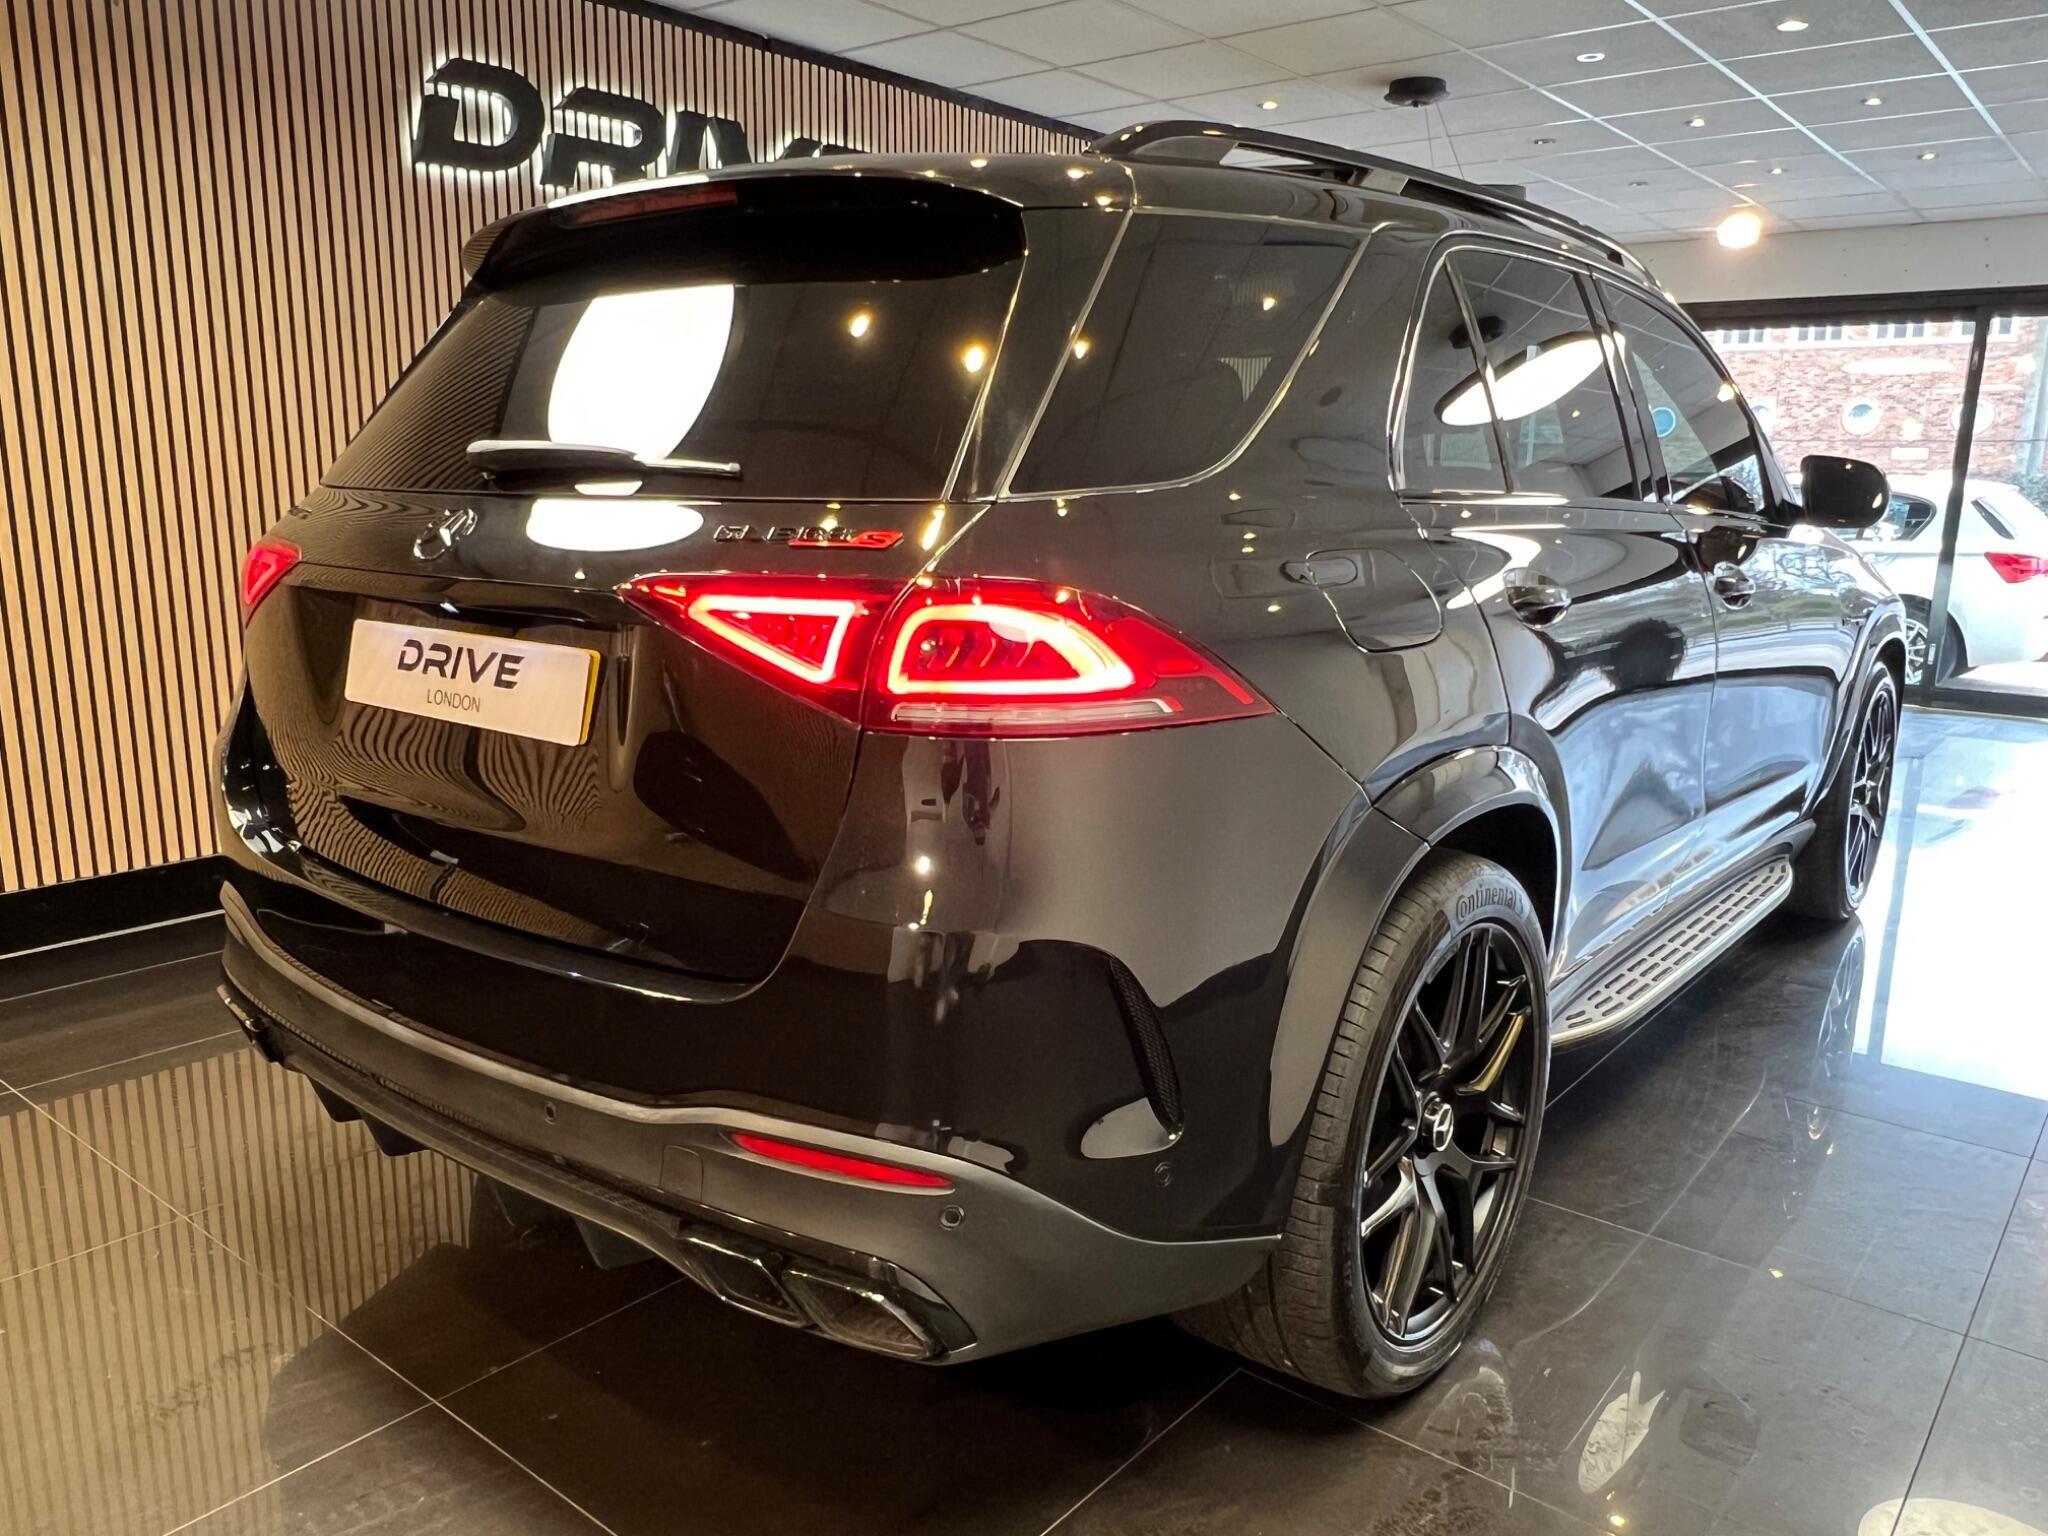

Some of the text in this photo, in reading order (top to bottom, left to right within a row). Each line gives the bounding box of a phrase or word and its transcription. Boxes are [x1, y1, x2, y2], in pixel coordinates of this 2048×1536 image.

[397, 639, 525, 690] DRIVE
[427, 688, 481, 713] LONDON
[1455, 884, 1517, 924] Continental
